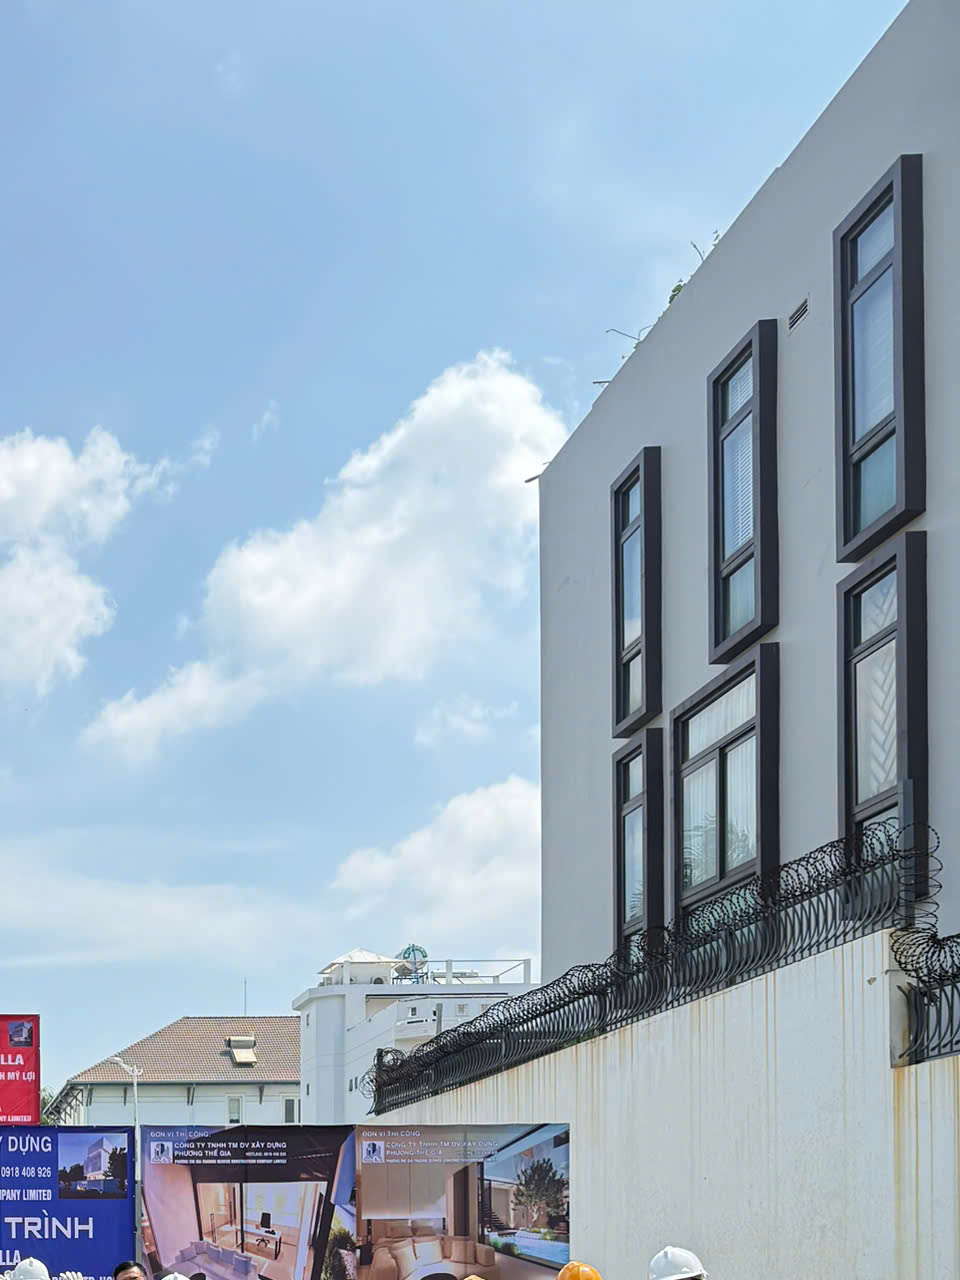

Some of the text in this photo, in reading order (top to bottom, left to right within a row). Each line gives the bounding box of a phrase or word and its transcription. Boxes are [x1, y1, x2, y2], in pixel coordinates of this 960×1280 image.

[8, 1134, 52, 1156] DỰNG
[0, 1166, 19, 1178] 0918
[21, 1166, 36, 1178] 408
[37, 1167, 52, 1178] 926
[22, 1188, 52, 1201] LIMITED
[4, 1209, 94, 1239] TRÌNH
